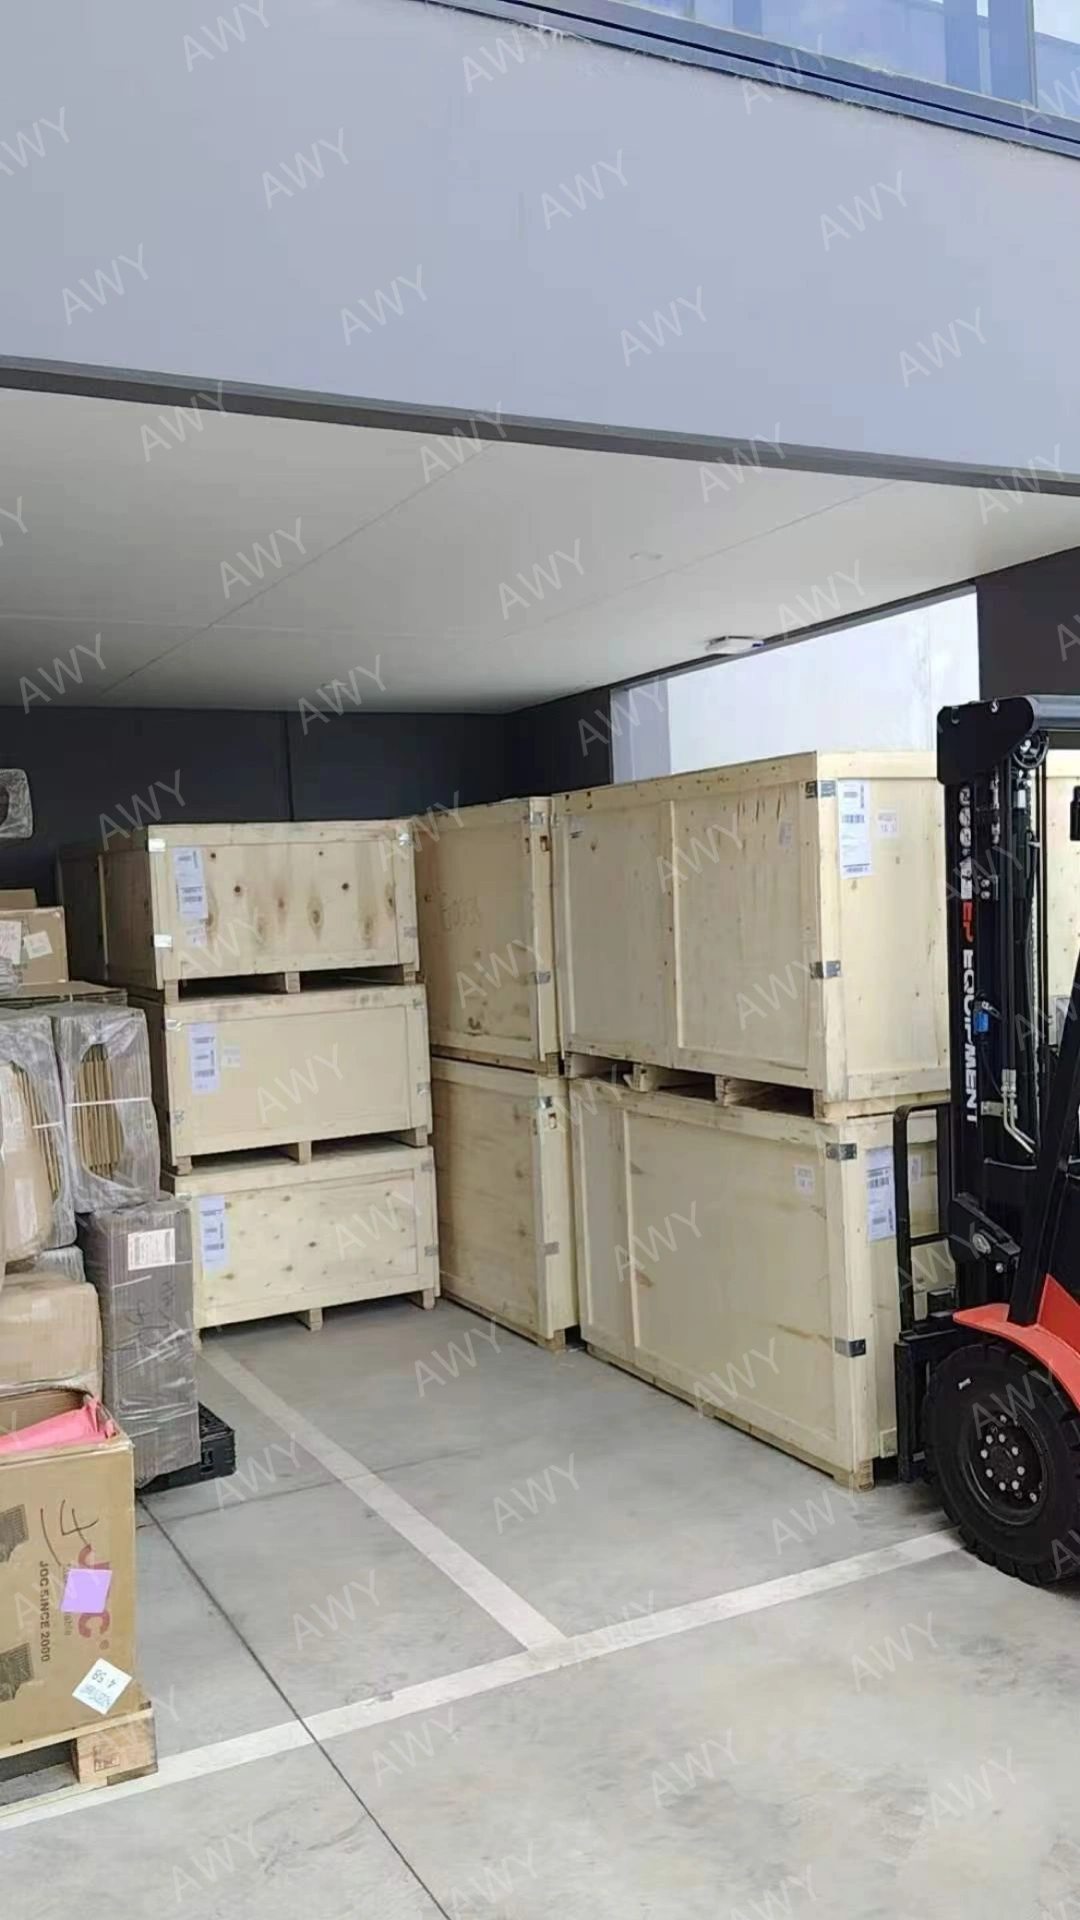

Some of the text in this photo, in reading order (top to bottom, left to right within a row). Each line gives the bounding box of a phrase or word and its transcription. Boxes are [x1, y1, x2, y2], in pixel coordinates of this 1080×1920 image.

[962, 901, 974, 943] EP
[39, 1589, 50, 1630] SINCE
[78, 1544, 111, 1638] JC
[40, 1631, 51, 1662] 2000
